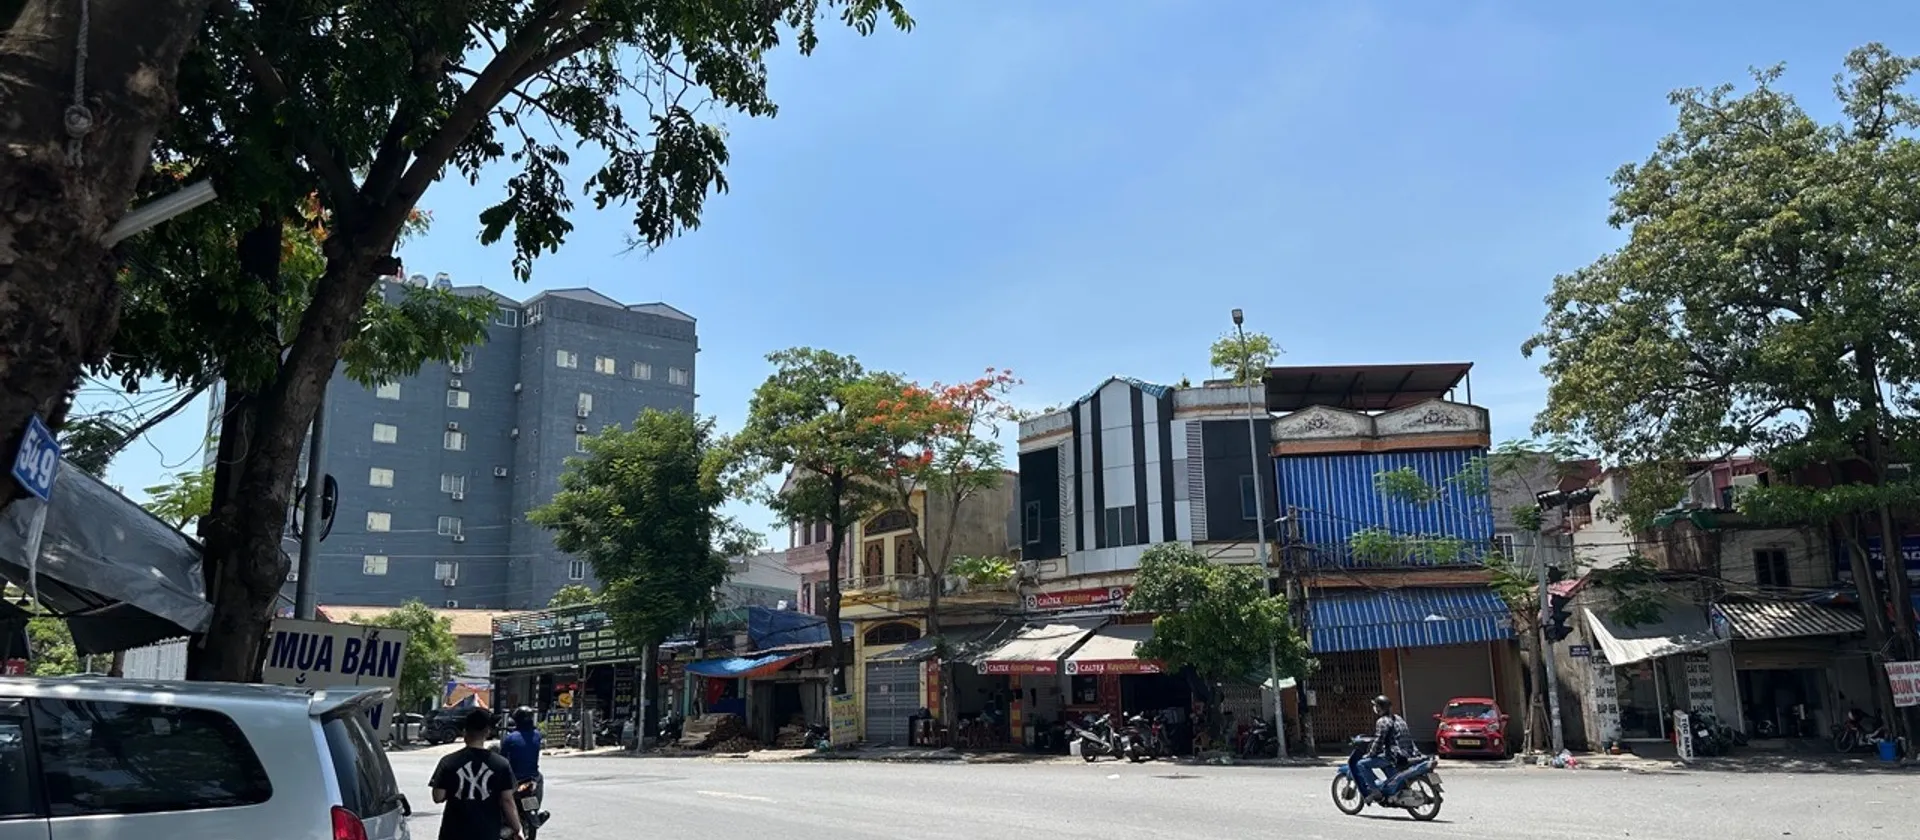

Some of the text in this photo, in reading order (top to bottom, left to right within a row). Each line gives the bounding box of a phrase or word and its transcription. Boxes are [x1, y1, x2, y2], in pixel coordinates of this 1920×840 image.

[20, 428, 55, 489] 549
[270, 631, 401, 678] MUA BÁN
[549, 635, 557, 648] Ô
[558, 632, 572, 647] TÔ
[1080, 664, 1105, 673] CALTEX
[455, 761, 494, 800] NY
